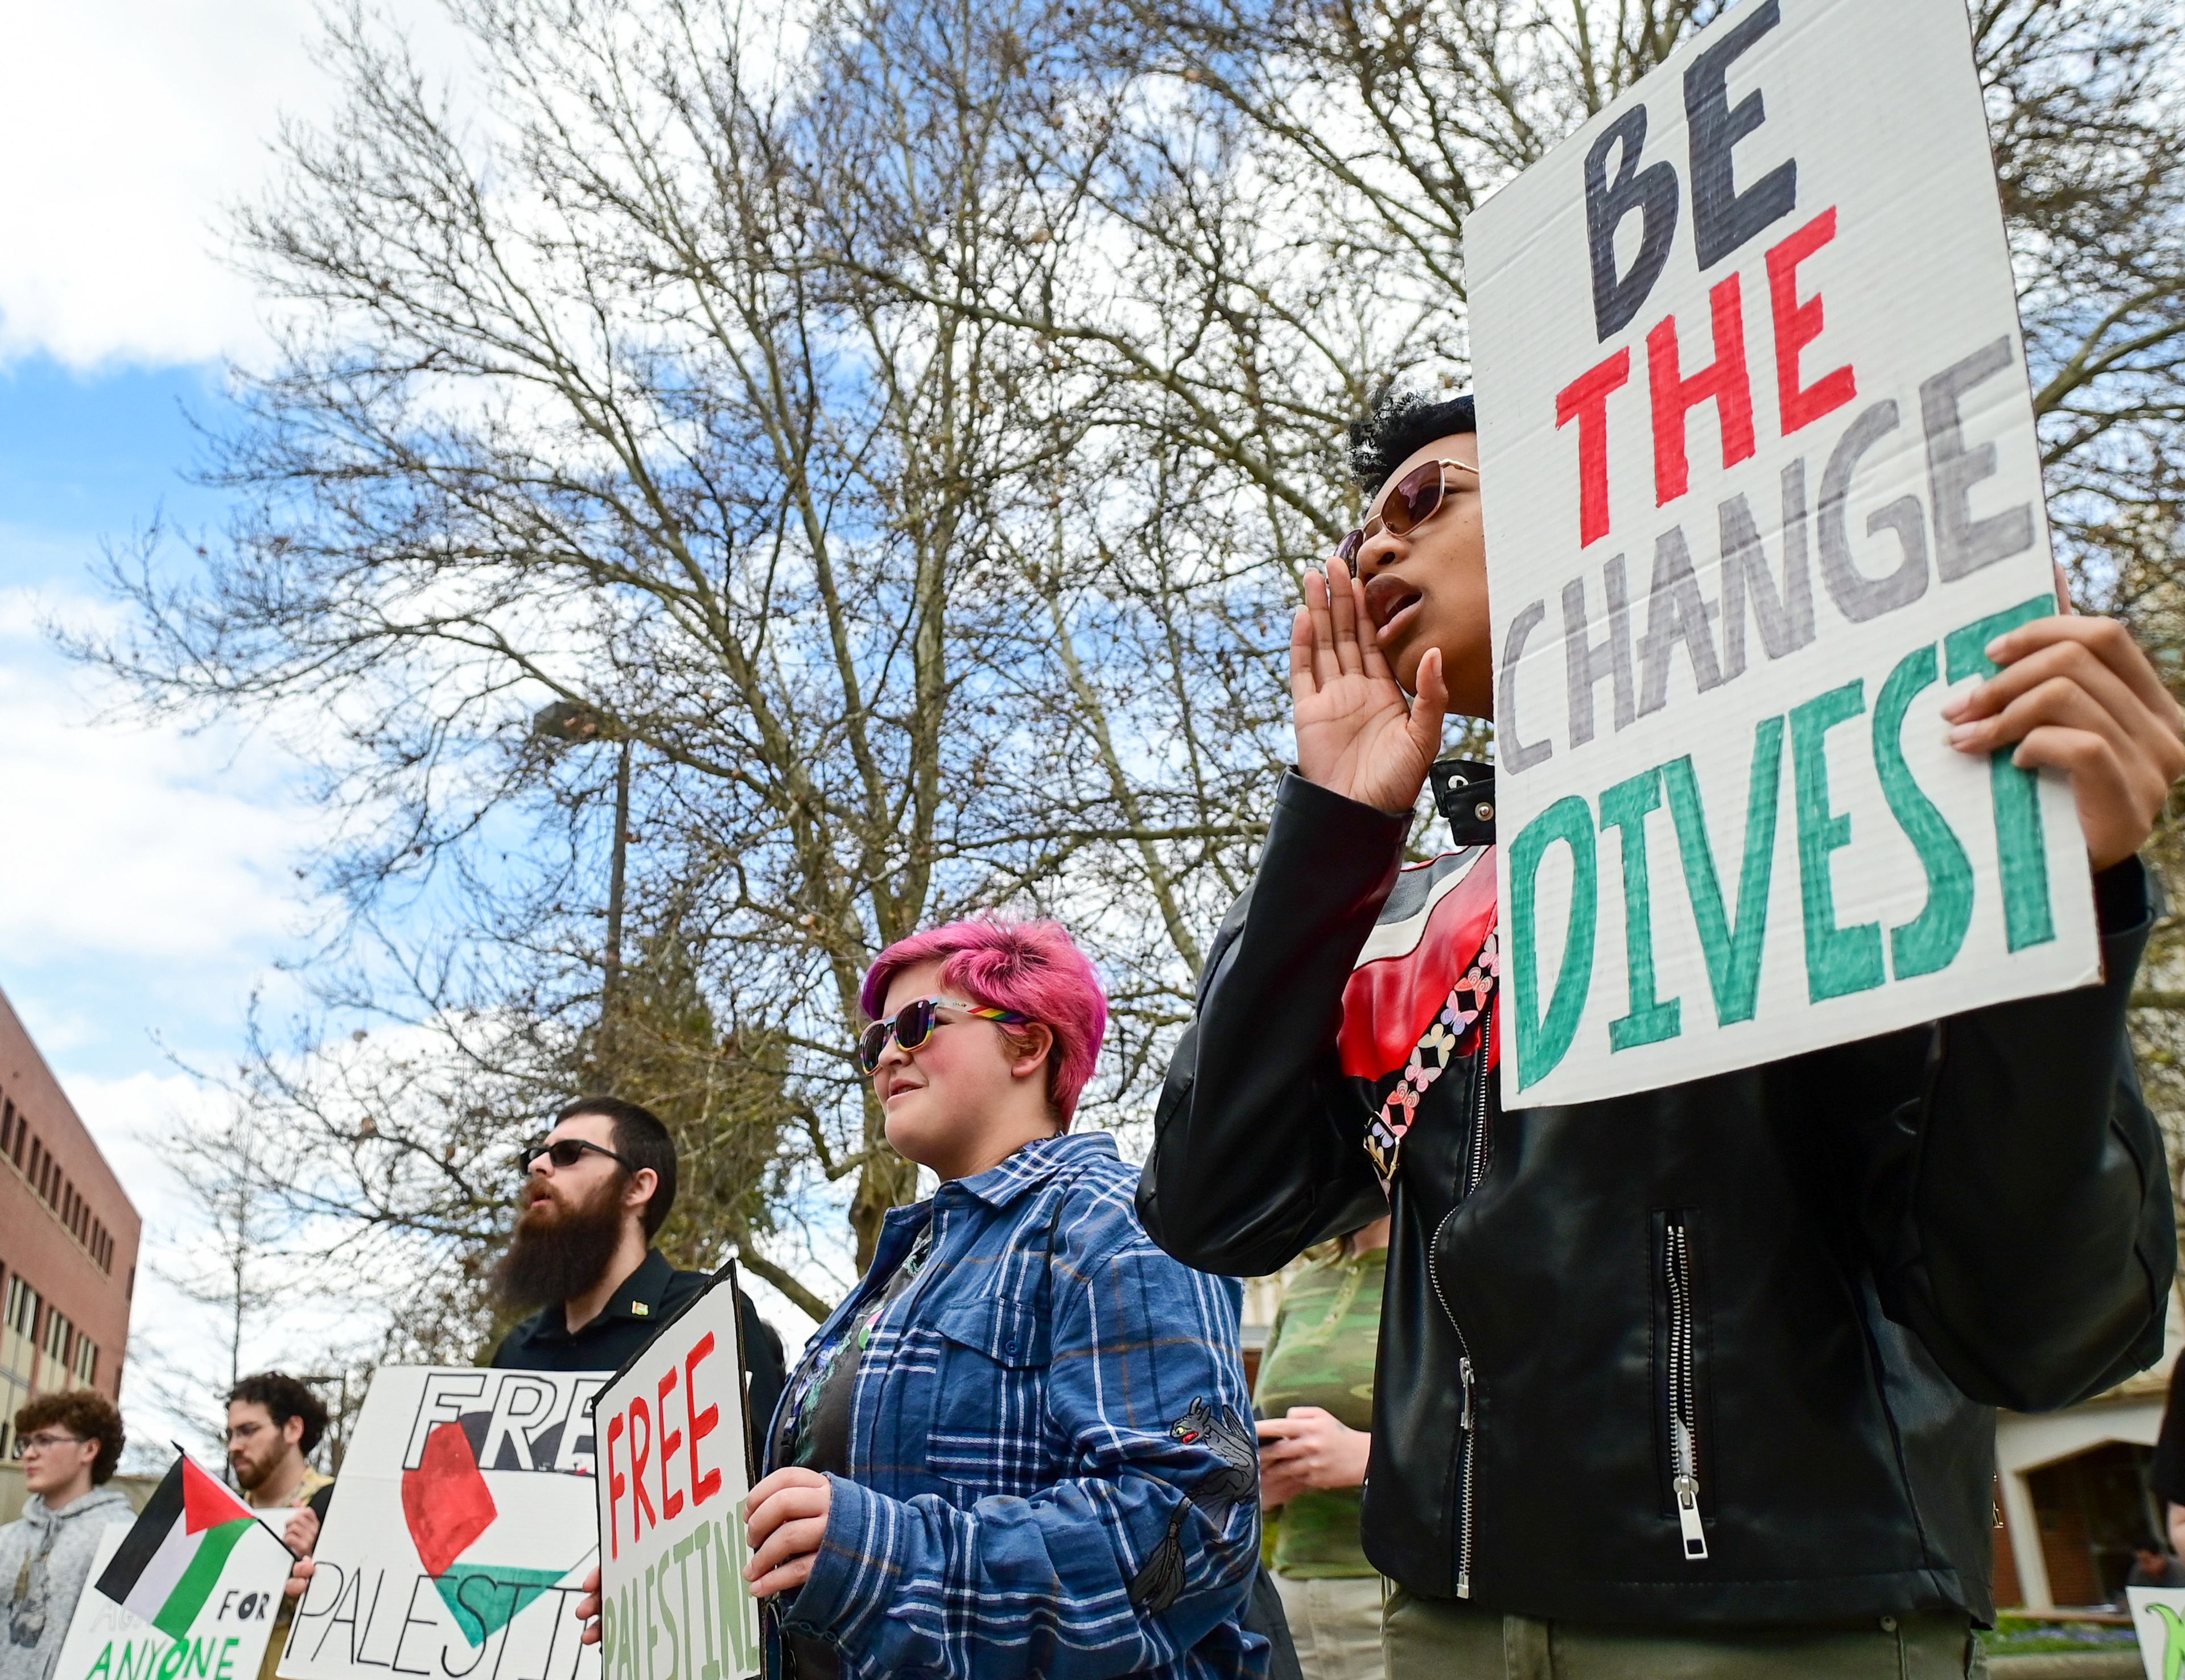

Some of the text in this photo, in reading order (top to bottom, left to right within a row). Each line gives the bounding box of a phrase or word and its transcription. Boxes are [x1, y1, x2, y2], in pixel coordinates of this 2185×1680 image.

[1585, 0, 1796, 344] BE
[1555, 205, 1857, 549] THE
[1496, 335, 2035, 775] CHANGE
[1509, 593, 2055, 1095] DIVEST
[402, 1373, 608, 1477] FRE
[607, 1331, 722, 1562] FREE
[84, 1637, 240, 1680] ANYONE
[218, 1590, 270, 1621] FOR
[604, 1498, 760, 1680] PALESTINE
